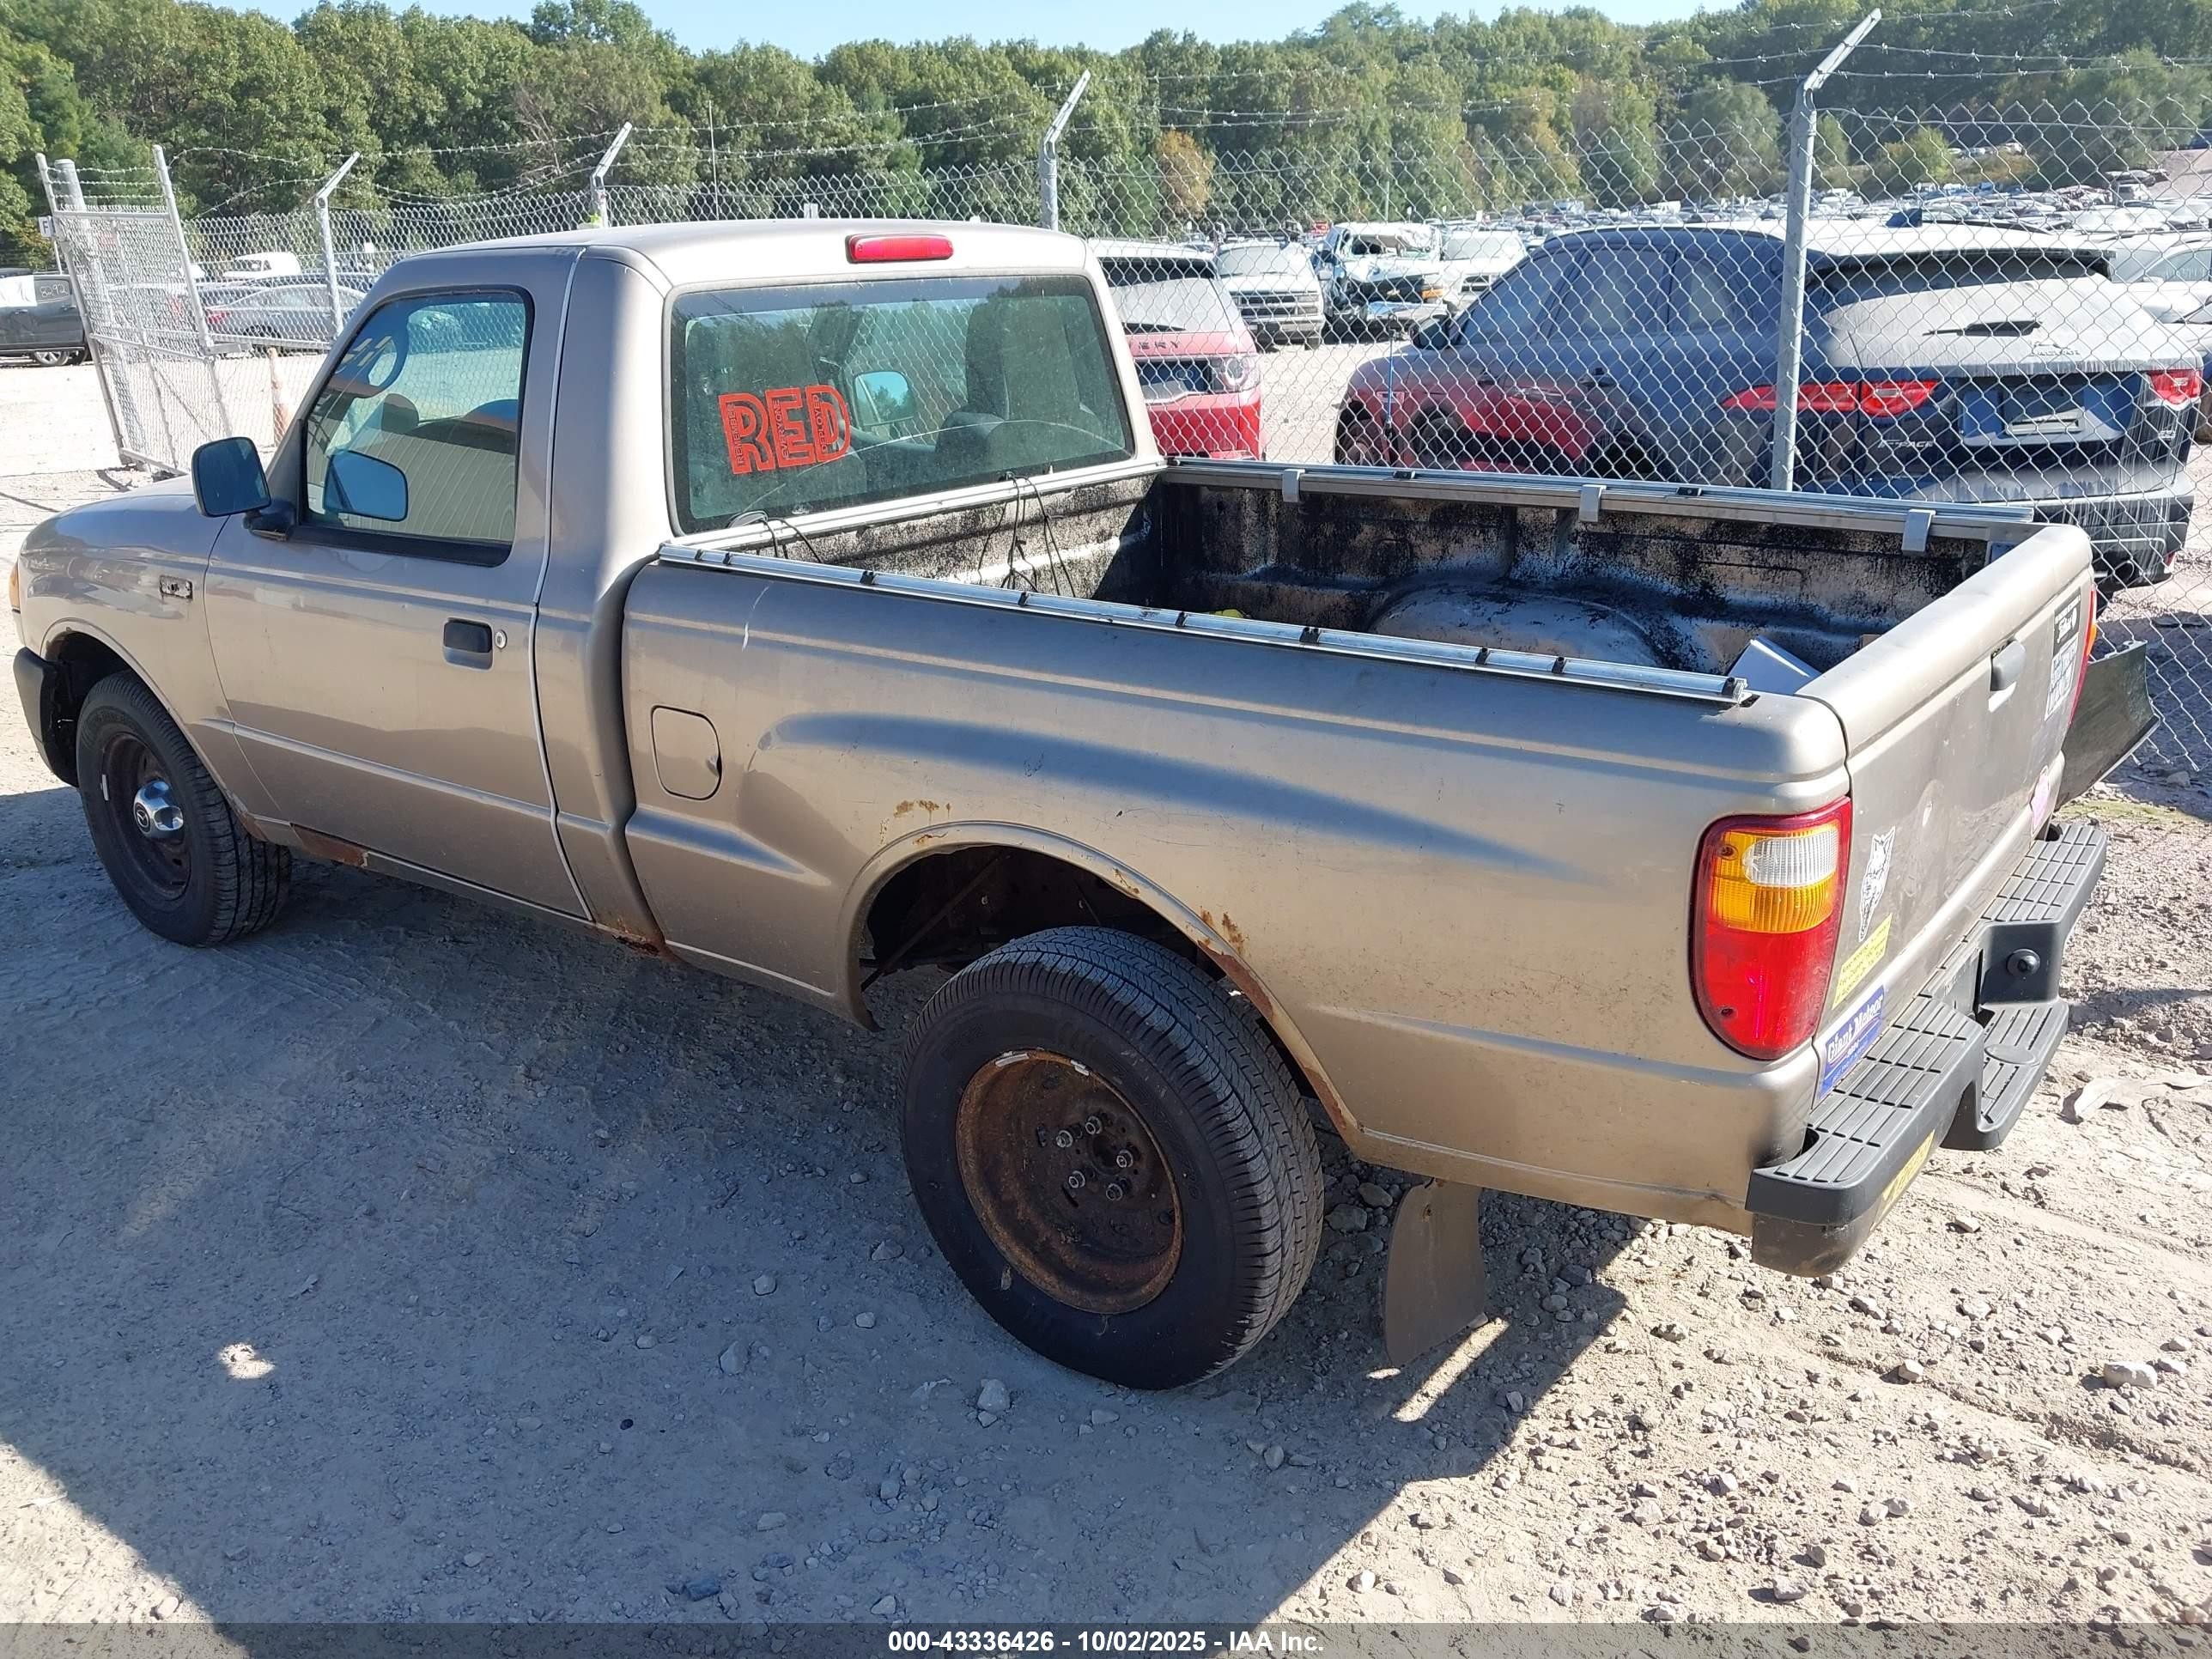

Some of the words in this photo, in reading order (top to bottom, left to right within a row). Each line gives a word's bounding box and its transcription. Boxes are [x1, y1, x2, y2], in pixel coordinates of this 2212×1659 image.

[718, 385, 851, 475] RED
[772, 398, 789, 459] EVERYONE
[813, 394, 828, 453] DEPLOYED
[1827, 1023, 1854, 1063] Giant
[1854, 994, 1884, 1034] Meteor
